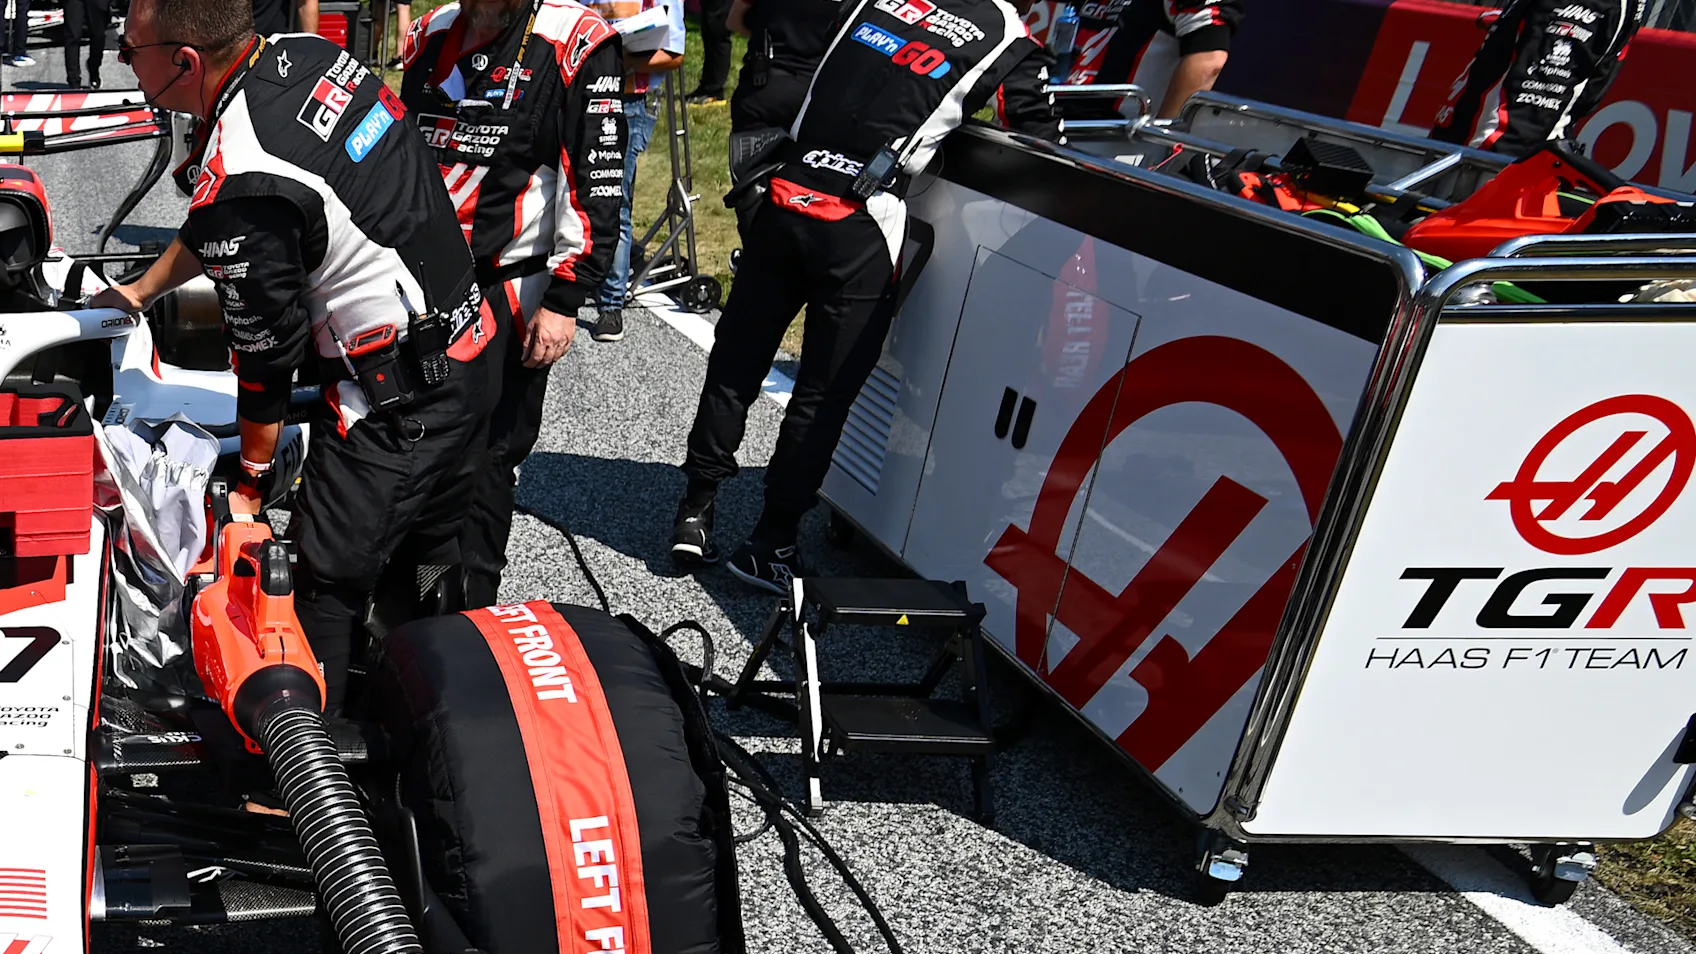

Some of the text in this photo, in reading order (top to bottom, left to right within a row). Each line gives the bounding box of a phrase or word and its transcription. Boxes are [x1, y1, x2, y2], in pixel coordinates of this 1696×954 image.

[934, 7, 985, 41] TOYOTA
[1553, 4, 1604, 24] HAAS
[918, 20, 966, 48] Racing
[925, 14, 975, 42] GAZOO
[855, 26, 946, 76] PLAY'n GO
[312, 86, 350, 137] GR
[588, 105, 610, 113] GR
[1516, 92, 1560, 111] ZOOMEX
[351, 109, 390, 156] PLAY'n
[451, 131, 501, 145] GAZOO
[457, 121, 510, 136] TOYOTA
[448, 142, 495, 158] Racing
[198, 235, 246, 258] HAAS
[224, 262, 249, 270] TOYOTA
[1399, 567, 1696, 629] TGR
[508, 620, 577, 704] FRONT
[1364, 648, 1491, 669] HAAS
[1564, 648, 1689, 669] TEAM
[569, 815, 622, 913] LEFT
